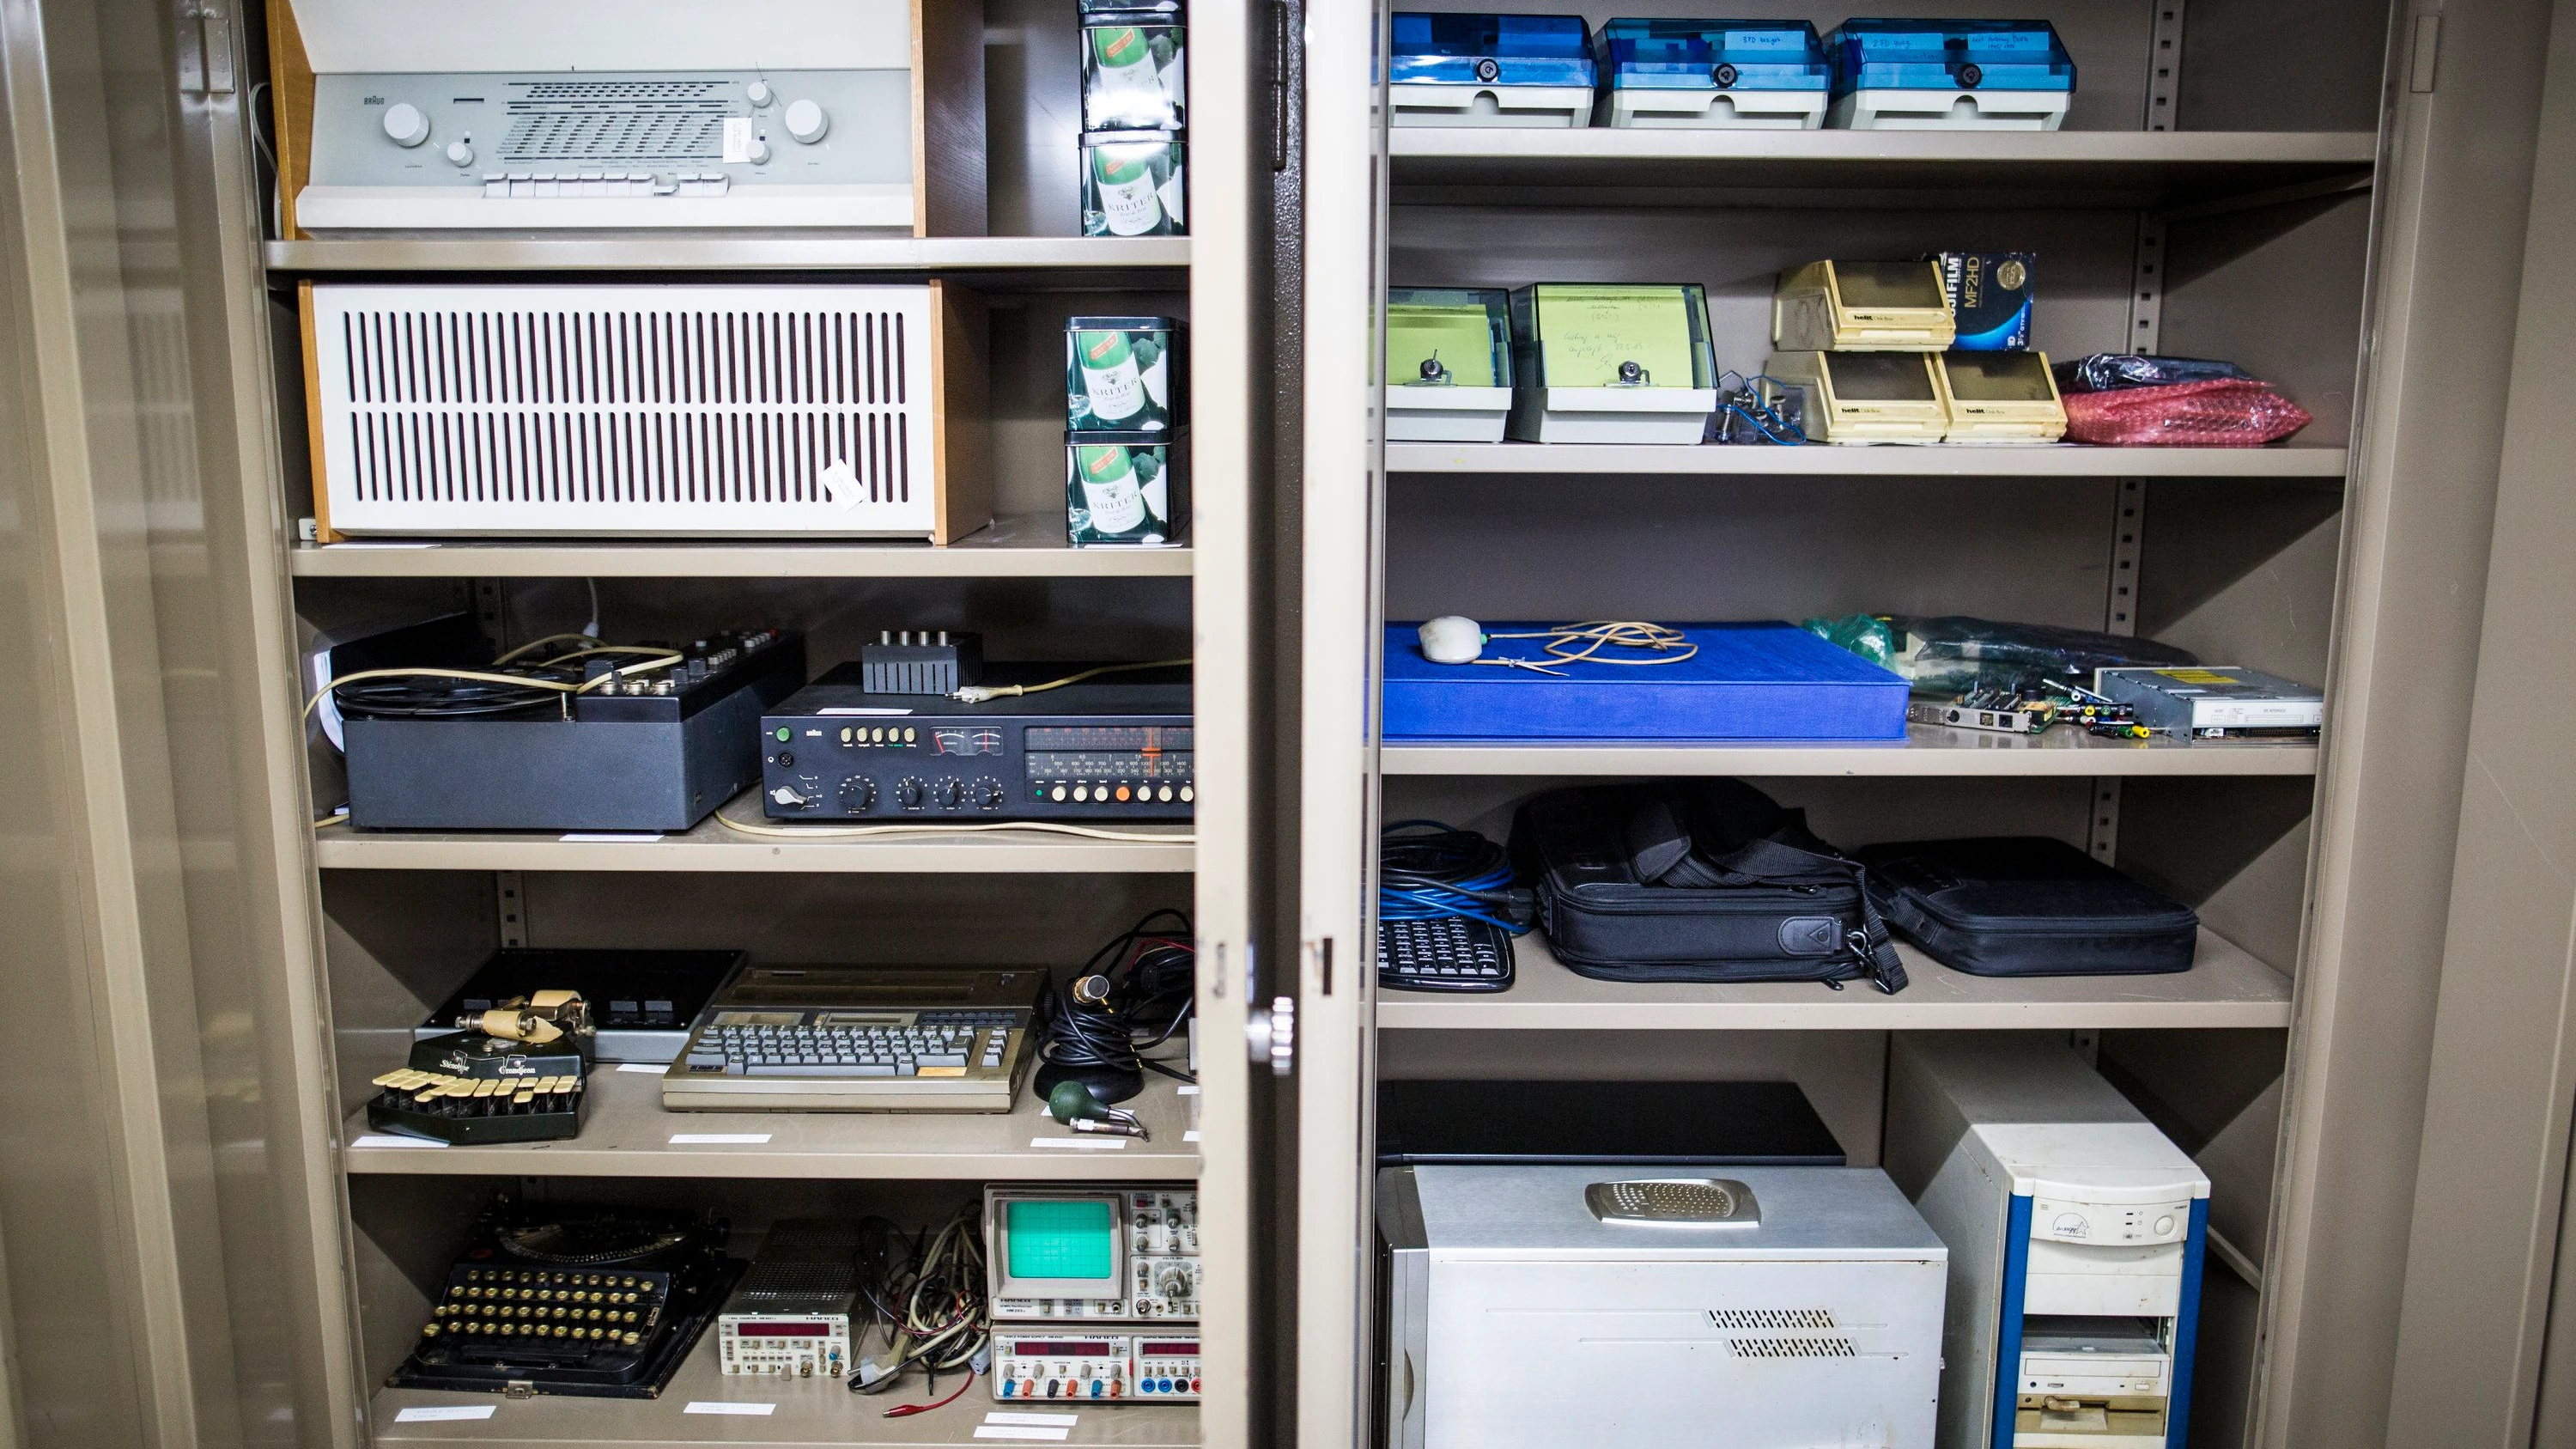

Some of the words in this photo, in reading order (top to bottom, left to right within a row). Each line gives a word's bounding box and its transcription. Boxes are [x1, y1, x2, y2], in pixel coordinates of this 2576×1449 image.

[364, 95, 385, 105] BRAUN
[1108, 192, 1153, 211] KRITER
[1965, 257, 1979, 307] MF2HD
[1092, 378, 1137, 396] KRITER
[1093, 490, 1138, 509] KRITER
[499, 1065, 536, 1075] Grandjean
